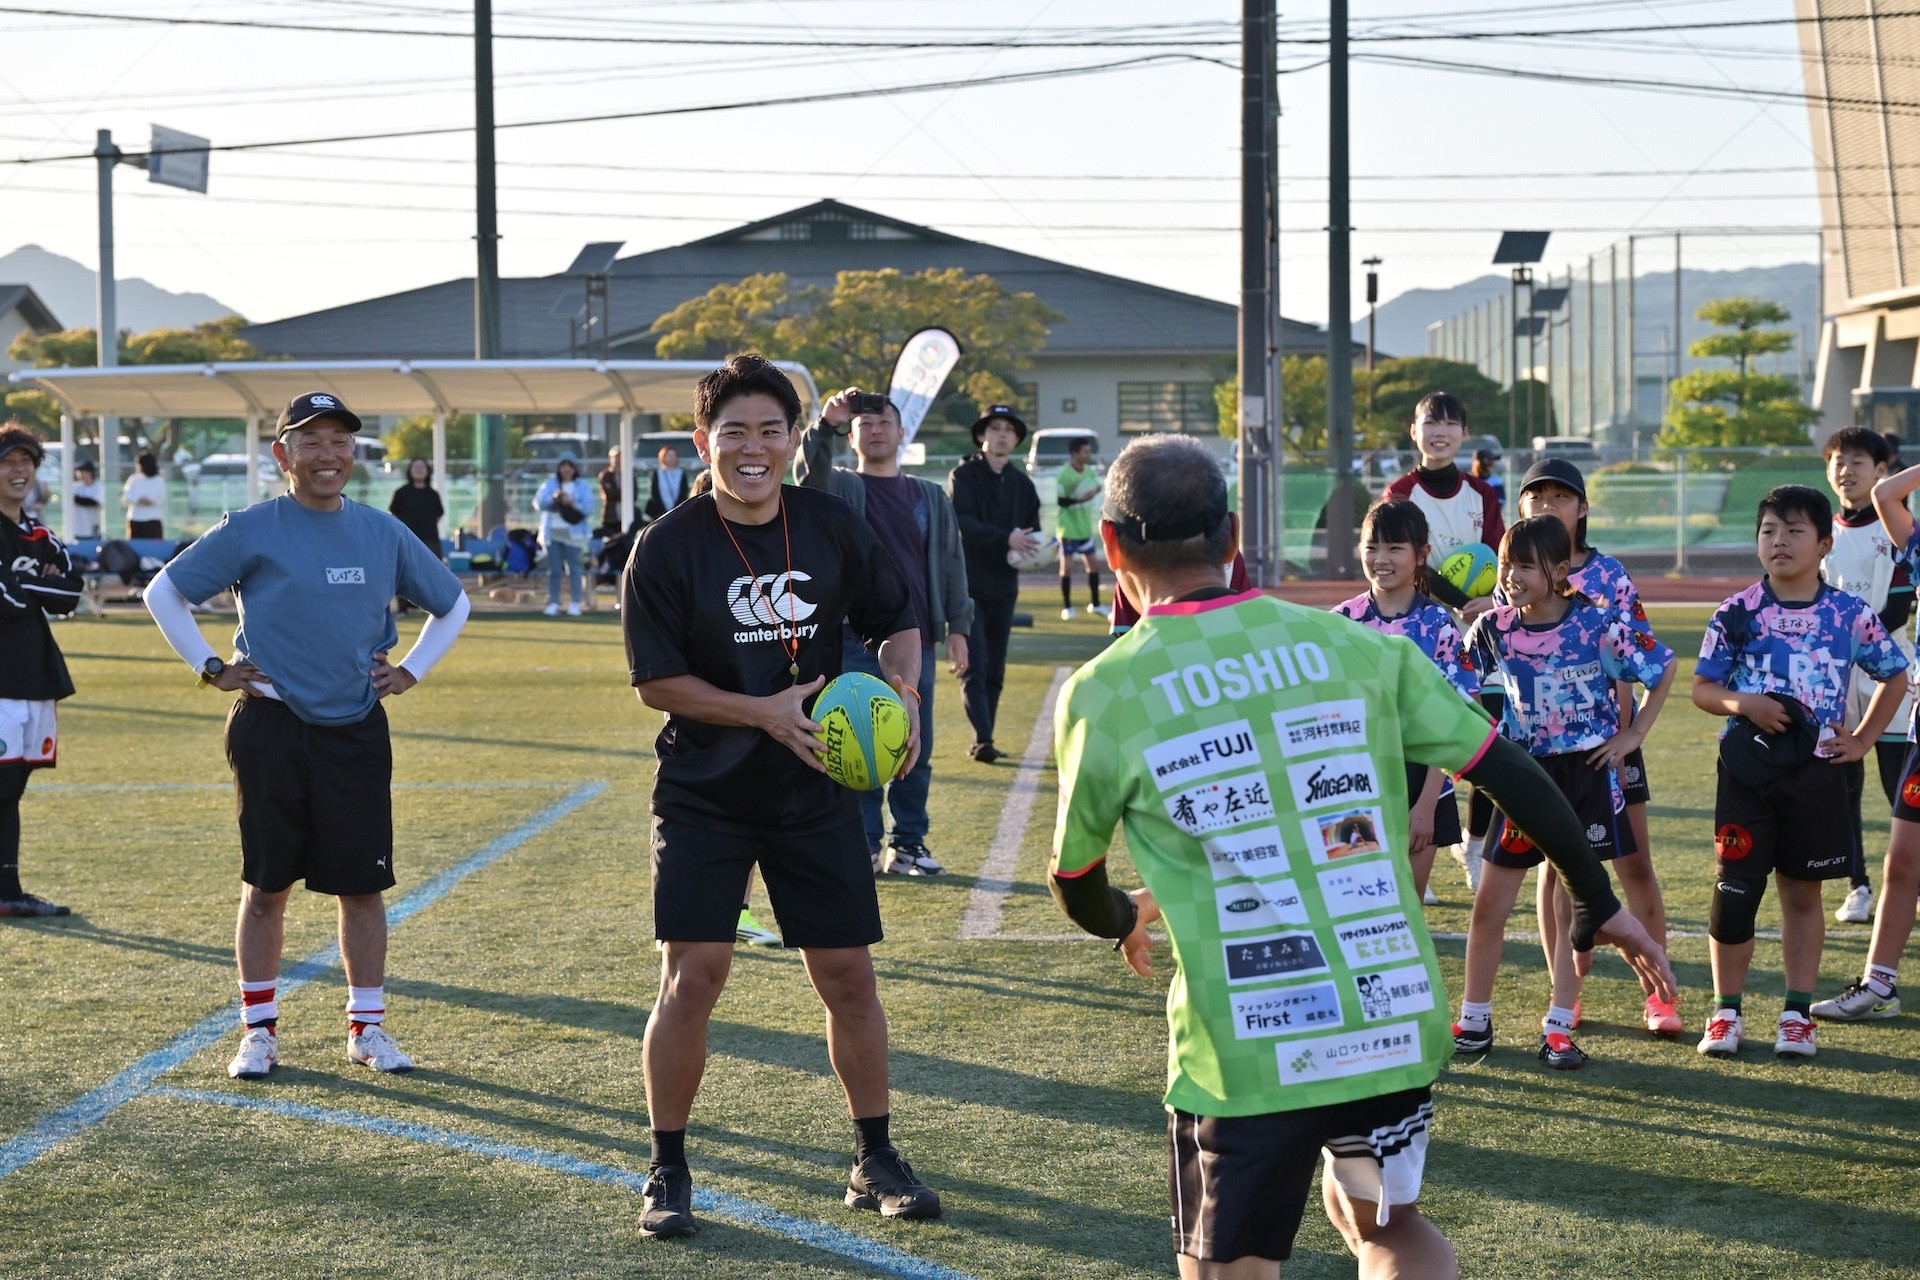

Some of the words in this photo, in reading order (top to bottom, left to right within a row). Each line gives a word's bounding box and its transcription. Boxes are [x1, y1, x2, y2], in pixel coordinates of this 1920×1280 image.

[331, 570, 362, 583] しげる
[733, 623, 819, 643] canterbury
[1777, 617, 1816, 630] まなと
[1151, 641, 1330, 716] TOSHIO
[1561, 662, 1598, 681] せいら
[1156, 756, 1202, 777] 株式会社
[1200, 732, 1254, 763] FUJI
[1237, 994, 1318, 1013] フィッシングボート
[1245, 1010, 1292, 1030] First
[1326, 1034, 1411, 1058] 山口つむぎ整体院
